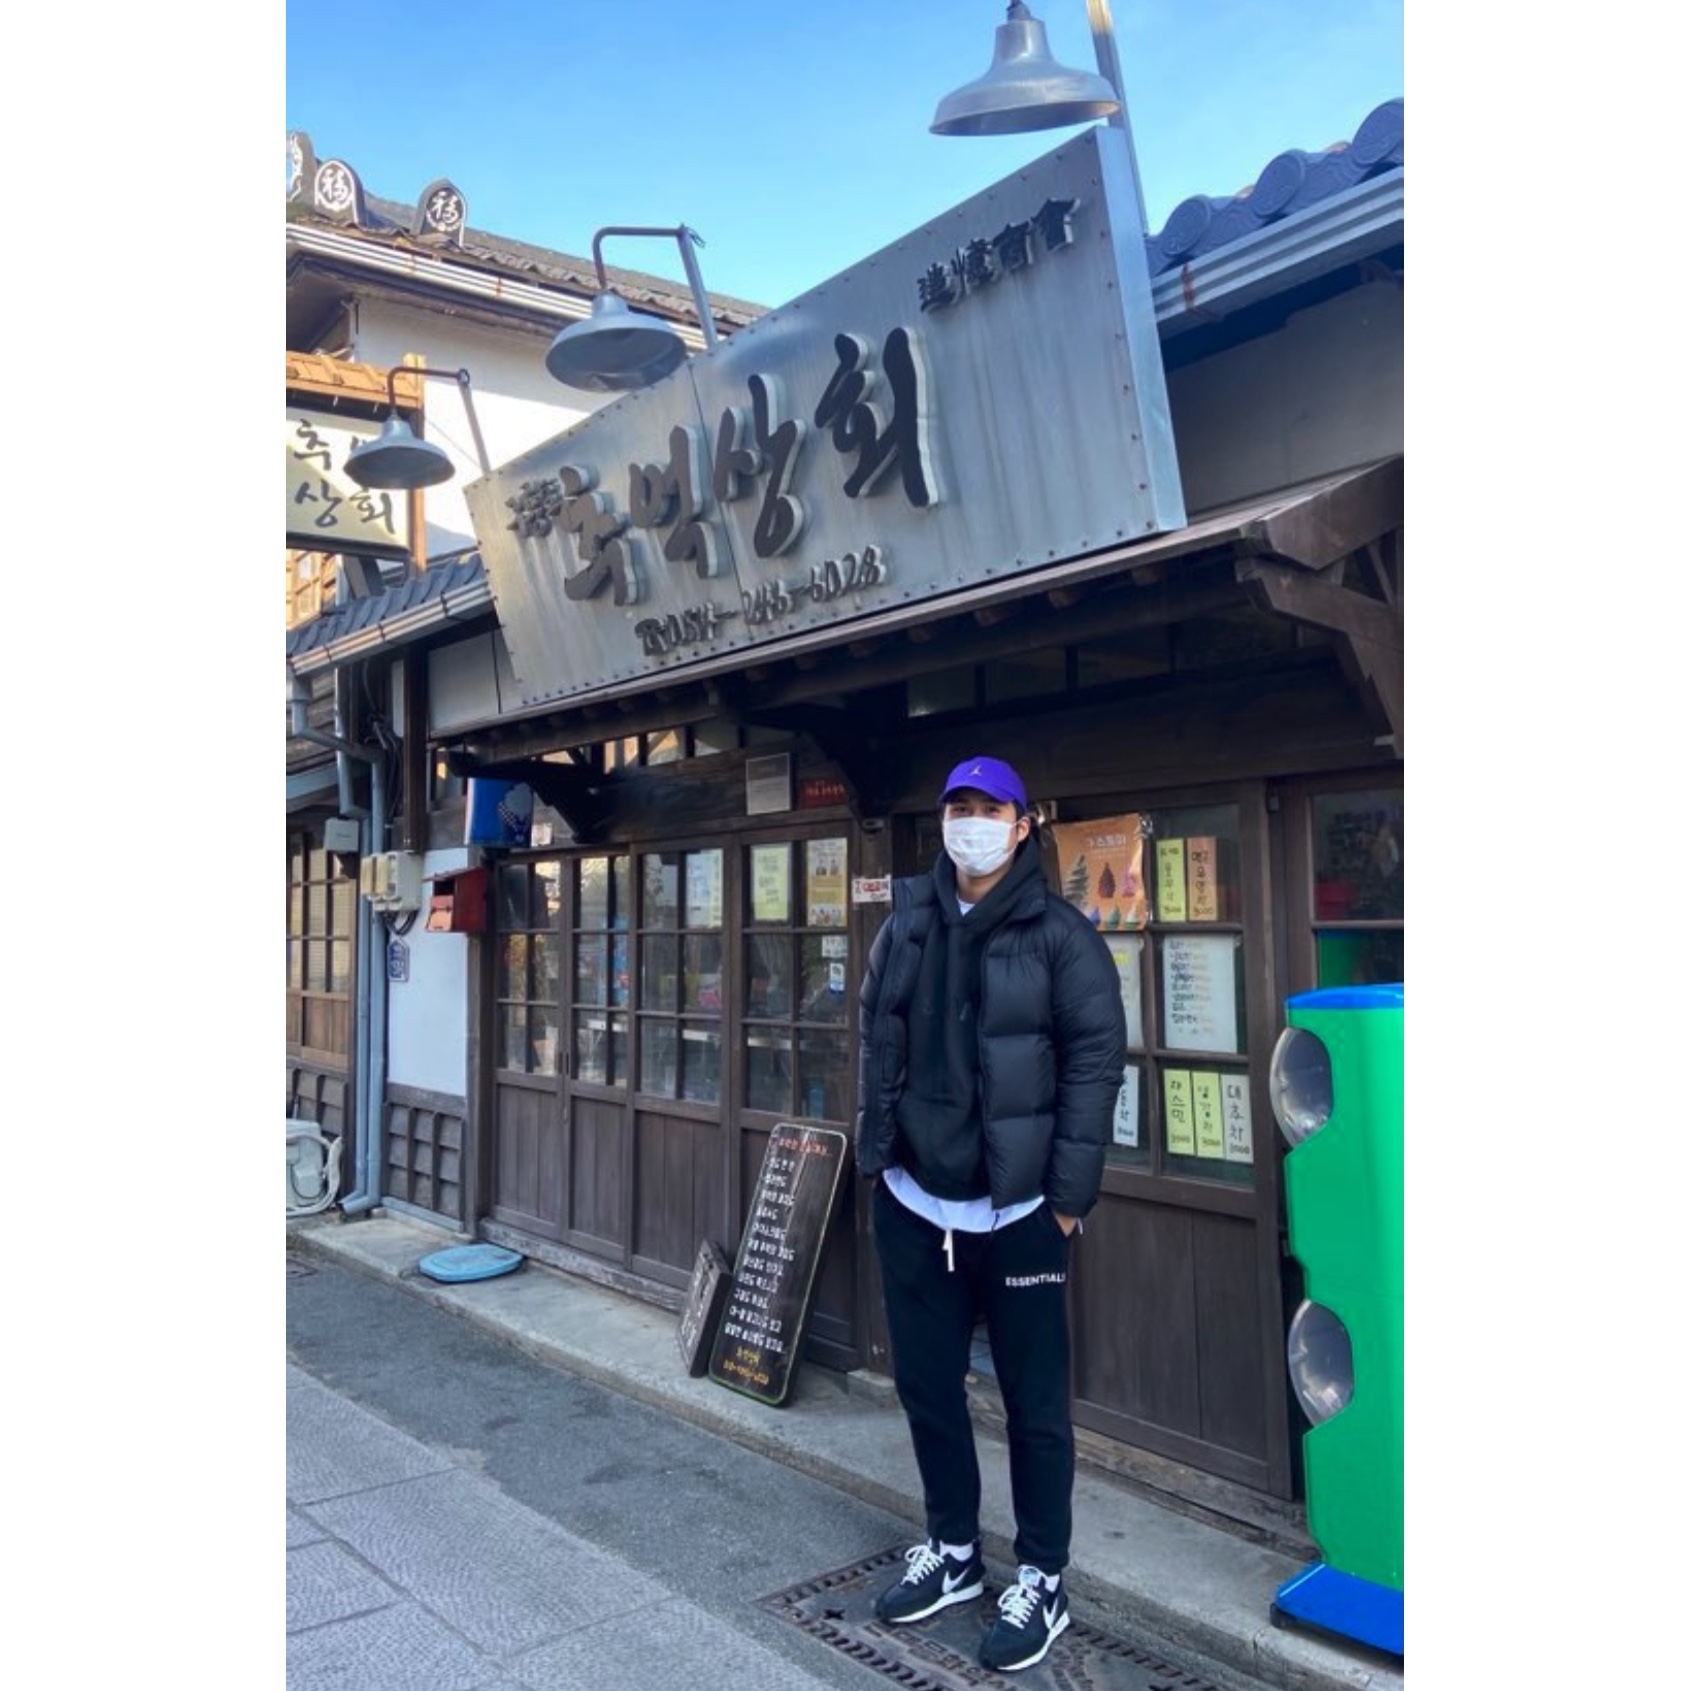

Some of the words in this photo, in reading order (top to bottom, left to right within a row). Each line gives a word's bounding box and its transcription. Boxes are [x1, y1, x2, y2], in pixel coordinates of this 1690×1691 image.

[431, 191, 459, 224] 福
[559, 327, 938, 606] 추억상회
[294, 479, 395, 534] 상회
[1227, 1085, 1245, 1142] 대추차
